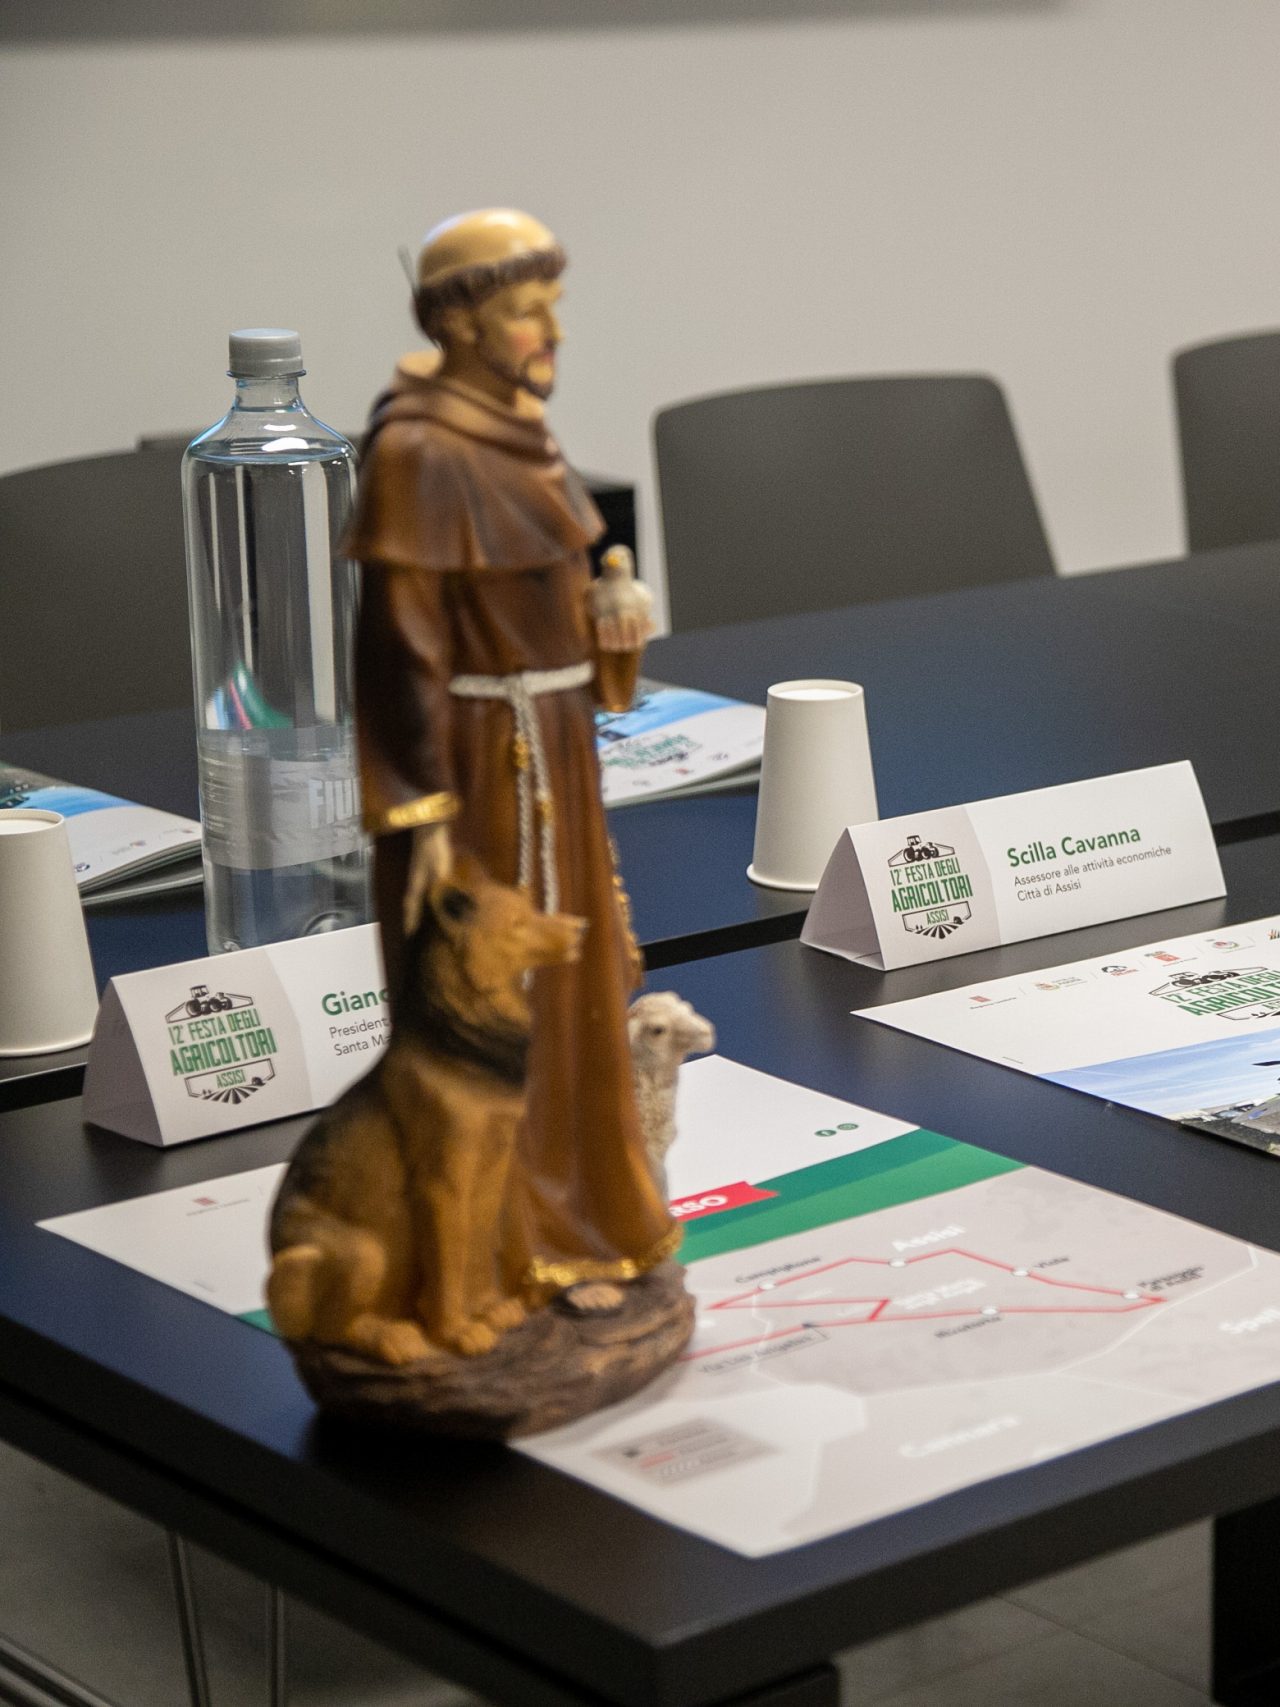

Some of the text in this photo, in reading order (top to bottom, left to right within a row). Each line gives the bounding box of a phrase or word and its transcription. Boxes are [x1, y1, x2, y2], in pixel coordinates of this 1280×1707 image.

[1007, 828, 1141, 867] Scilla Cavanna
[905, 863, 935, 883] FESTA
[934, 857, 960, 878] DEGLI
[1014, 845, 1172, 887] Assessore alle attività economiche
[891, 874, 973, 913] AGRICOLTORI
[1017, 879, 1082, 902] Città di Assisi
[926, 909, 949, 925] ASSISI
[1186, 981, 1247, 997] FESTA
[187, 1016, 227, 1042] FESTA
[226, 1008, 261, 1032] DEGLI
[328, 1017, 390, 1039] President
[170, 1027, 277, 1076] AGRICOLTORI
[333, 1040, 370, 1056] Santa
[216, 1069, 246, 1089] ASSISI
